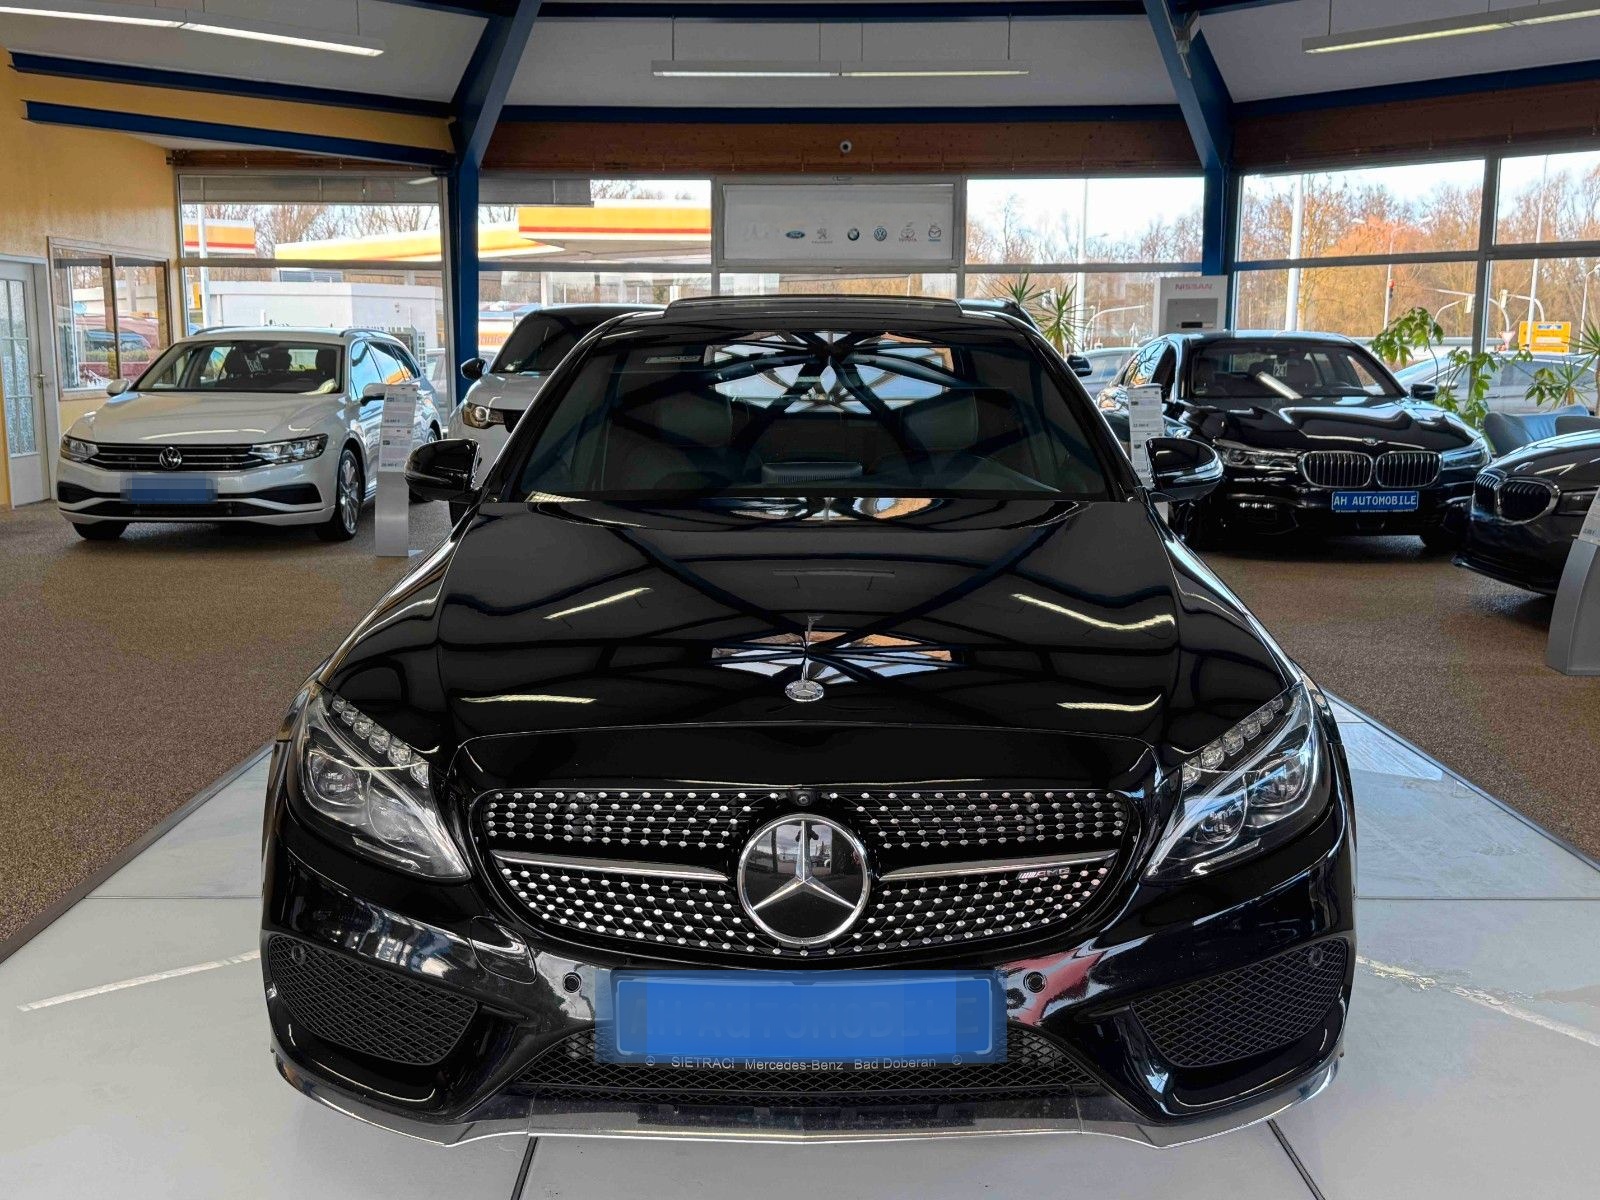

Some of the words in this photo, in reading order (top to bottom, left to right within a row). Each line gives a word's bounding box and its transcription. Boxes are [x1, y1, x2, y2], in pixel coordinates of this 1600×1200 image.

[1334, 496, 1347, 506] AH
[1352, 495, 1417, 506] AUTOMOBILE
[745, 1058, 844, 1071] Mercedes-Benz
[854, 1058, 879, 1070] Bad
[883, 1057, 936, 1069] Doberan
